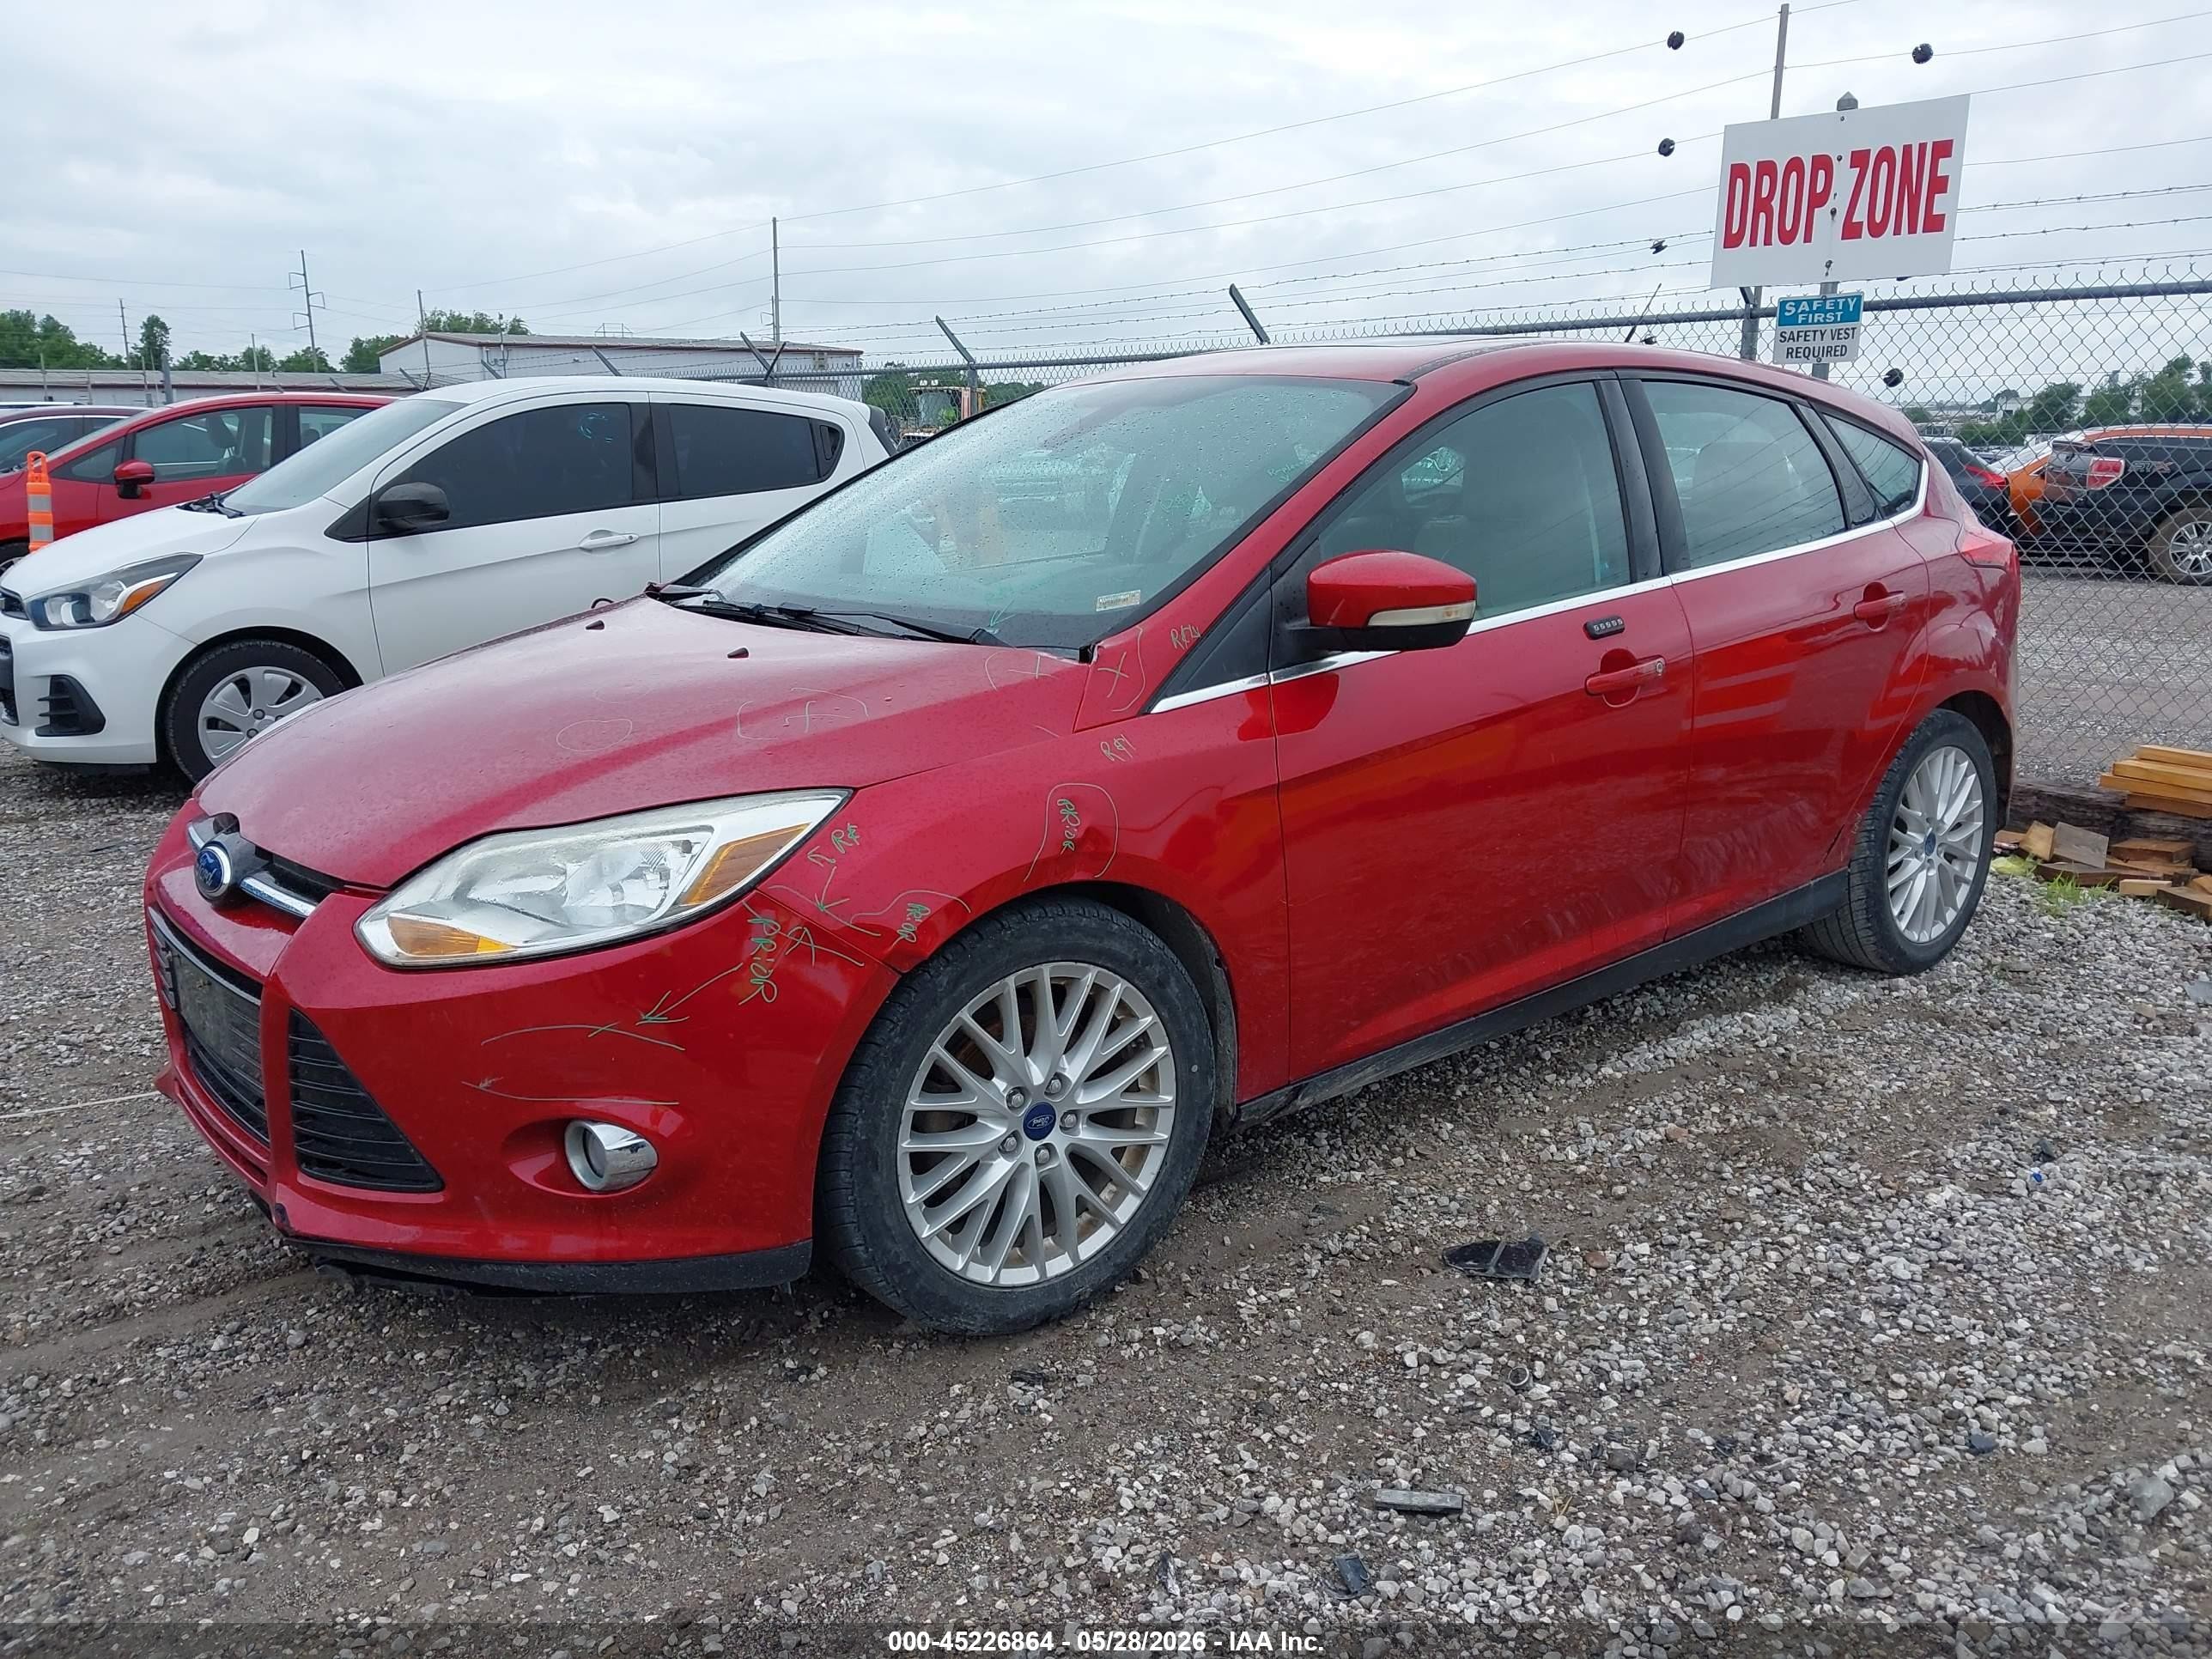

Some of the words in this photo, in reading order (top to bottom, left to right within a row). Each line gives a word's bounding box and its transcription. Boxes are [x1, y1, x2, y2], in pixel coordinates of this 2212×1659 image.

[1723, 153, 1835, 250] DROP
[1840, 138, 1954, 241] ZONE
[1784, 297, 1857, 316] SAFETY
[1797, 311, 1844, 324] FIRST
[1778, 329, 1827, 343] SAFETY
[1830, 327, 1857, 342] VEST
[1785, 344, 1848, 361] REQUIRED
